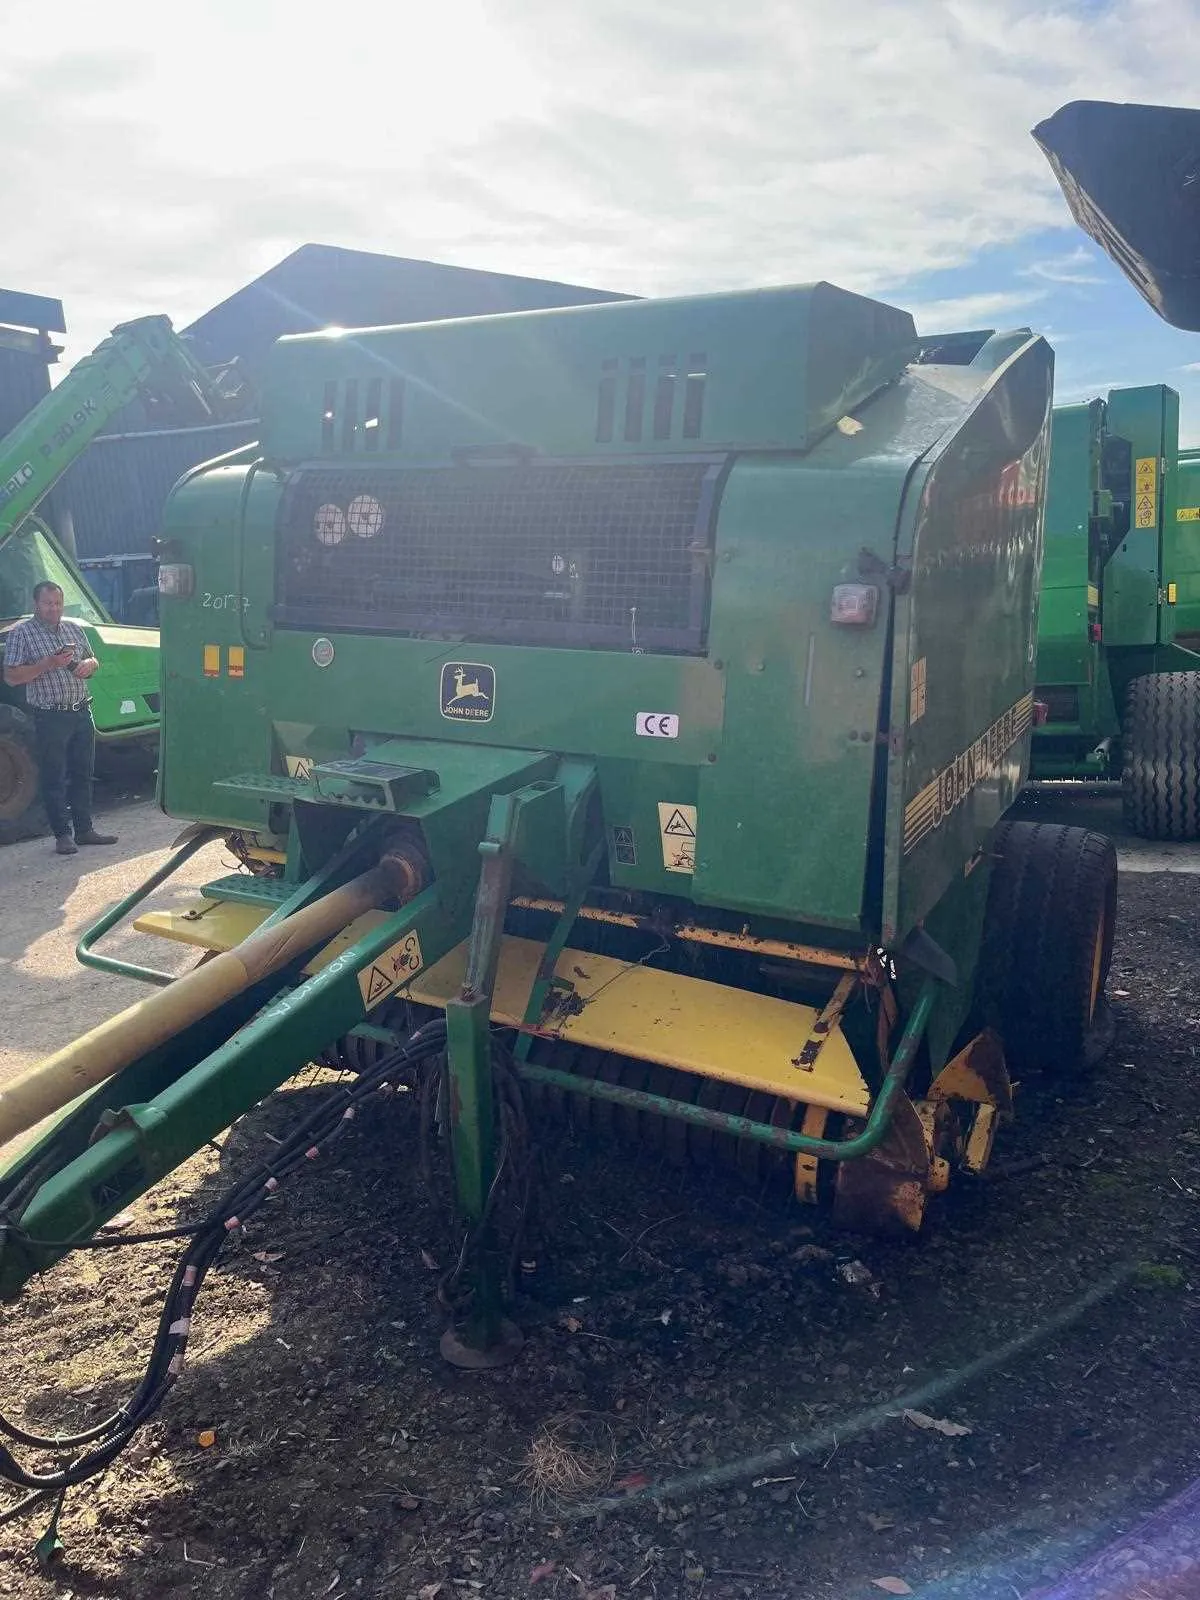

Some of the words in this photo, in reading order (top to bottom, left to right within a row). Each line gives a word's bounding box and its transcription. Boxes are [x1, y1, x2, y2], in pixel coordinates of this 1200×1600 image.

[444, 706, 464, 716] JOHN
[465, 708, 489, 717] DEERE
[644, 715, 670, 736] CE
[932, 740, 976, 829] JOHN
